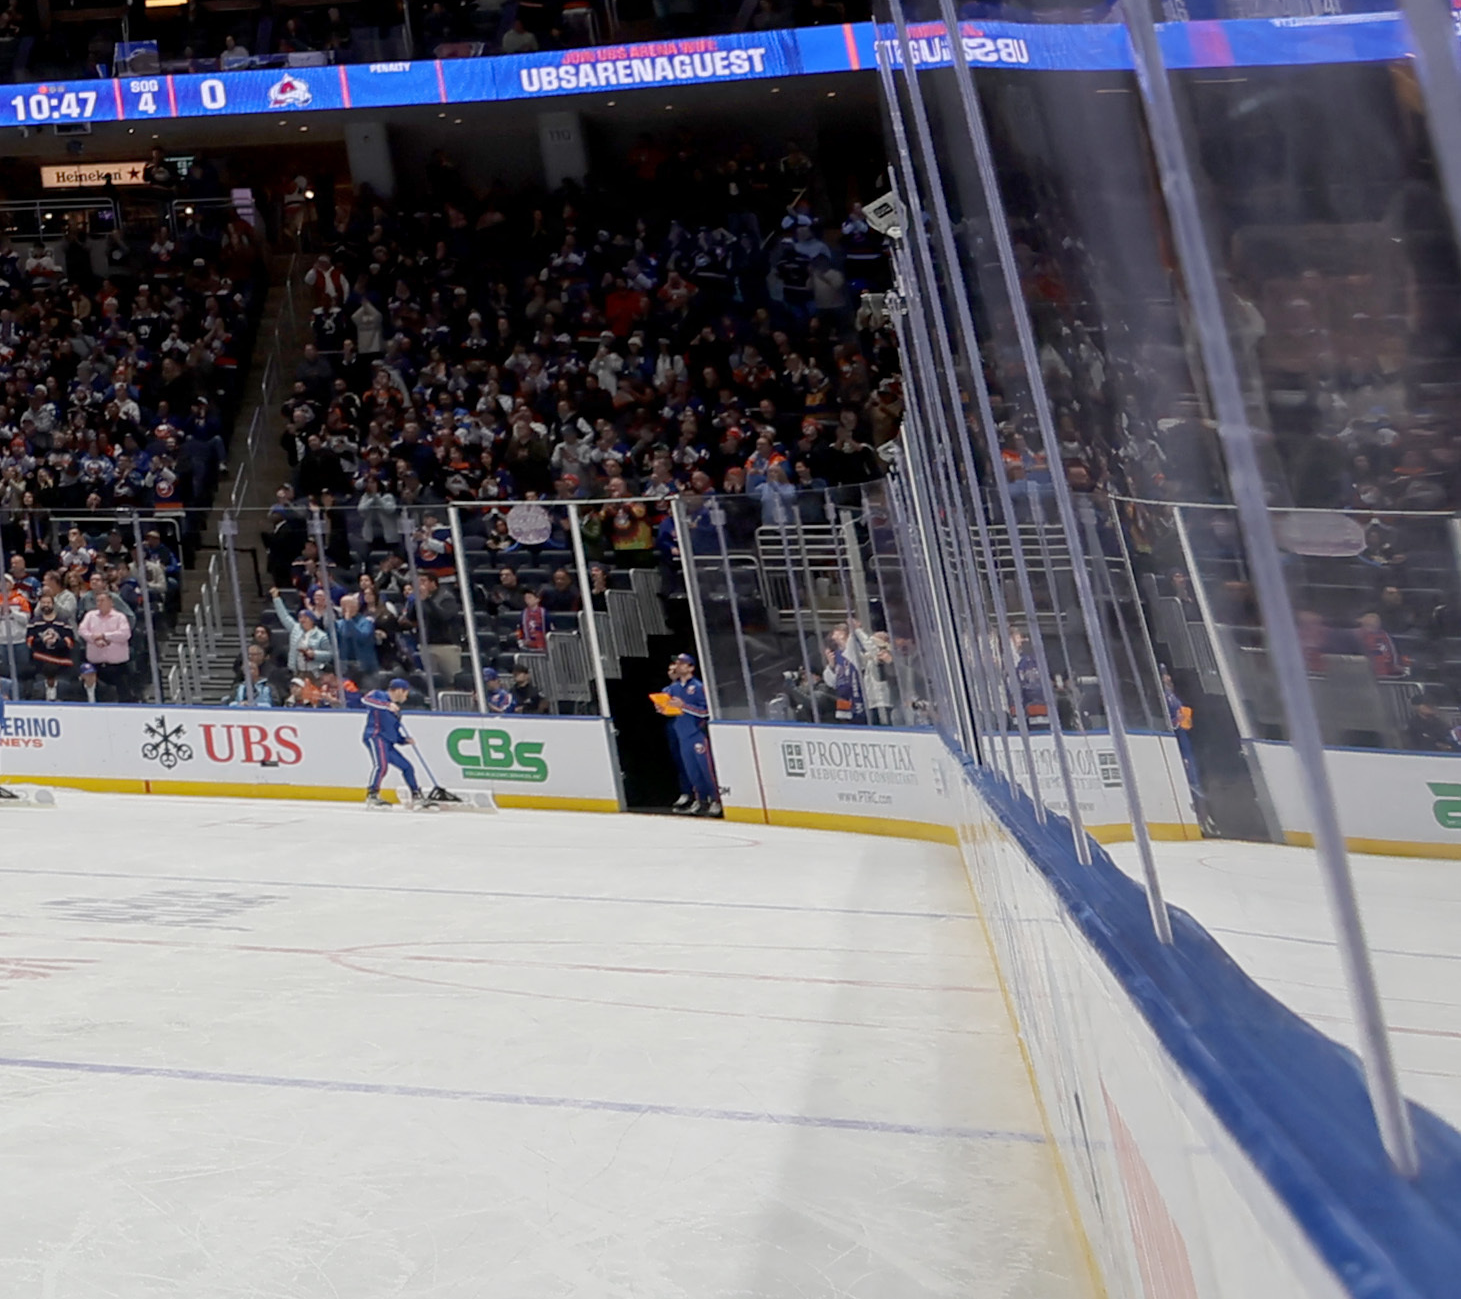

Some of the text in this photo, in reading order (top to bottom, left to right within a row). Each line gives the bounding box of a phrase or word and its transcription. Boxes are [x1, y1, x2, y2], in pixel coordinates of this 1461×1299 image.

[520, 47, 766, 93] UBSARENAGUEST
[12, 90, 97, 123] 10:47
[198, 724, 303, 765] UBS
[805, 740, 915, 771] PROPERTY TAX
